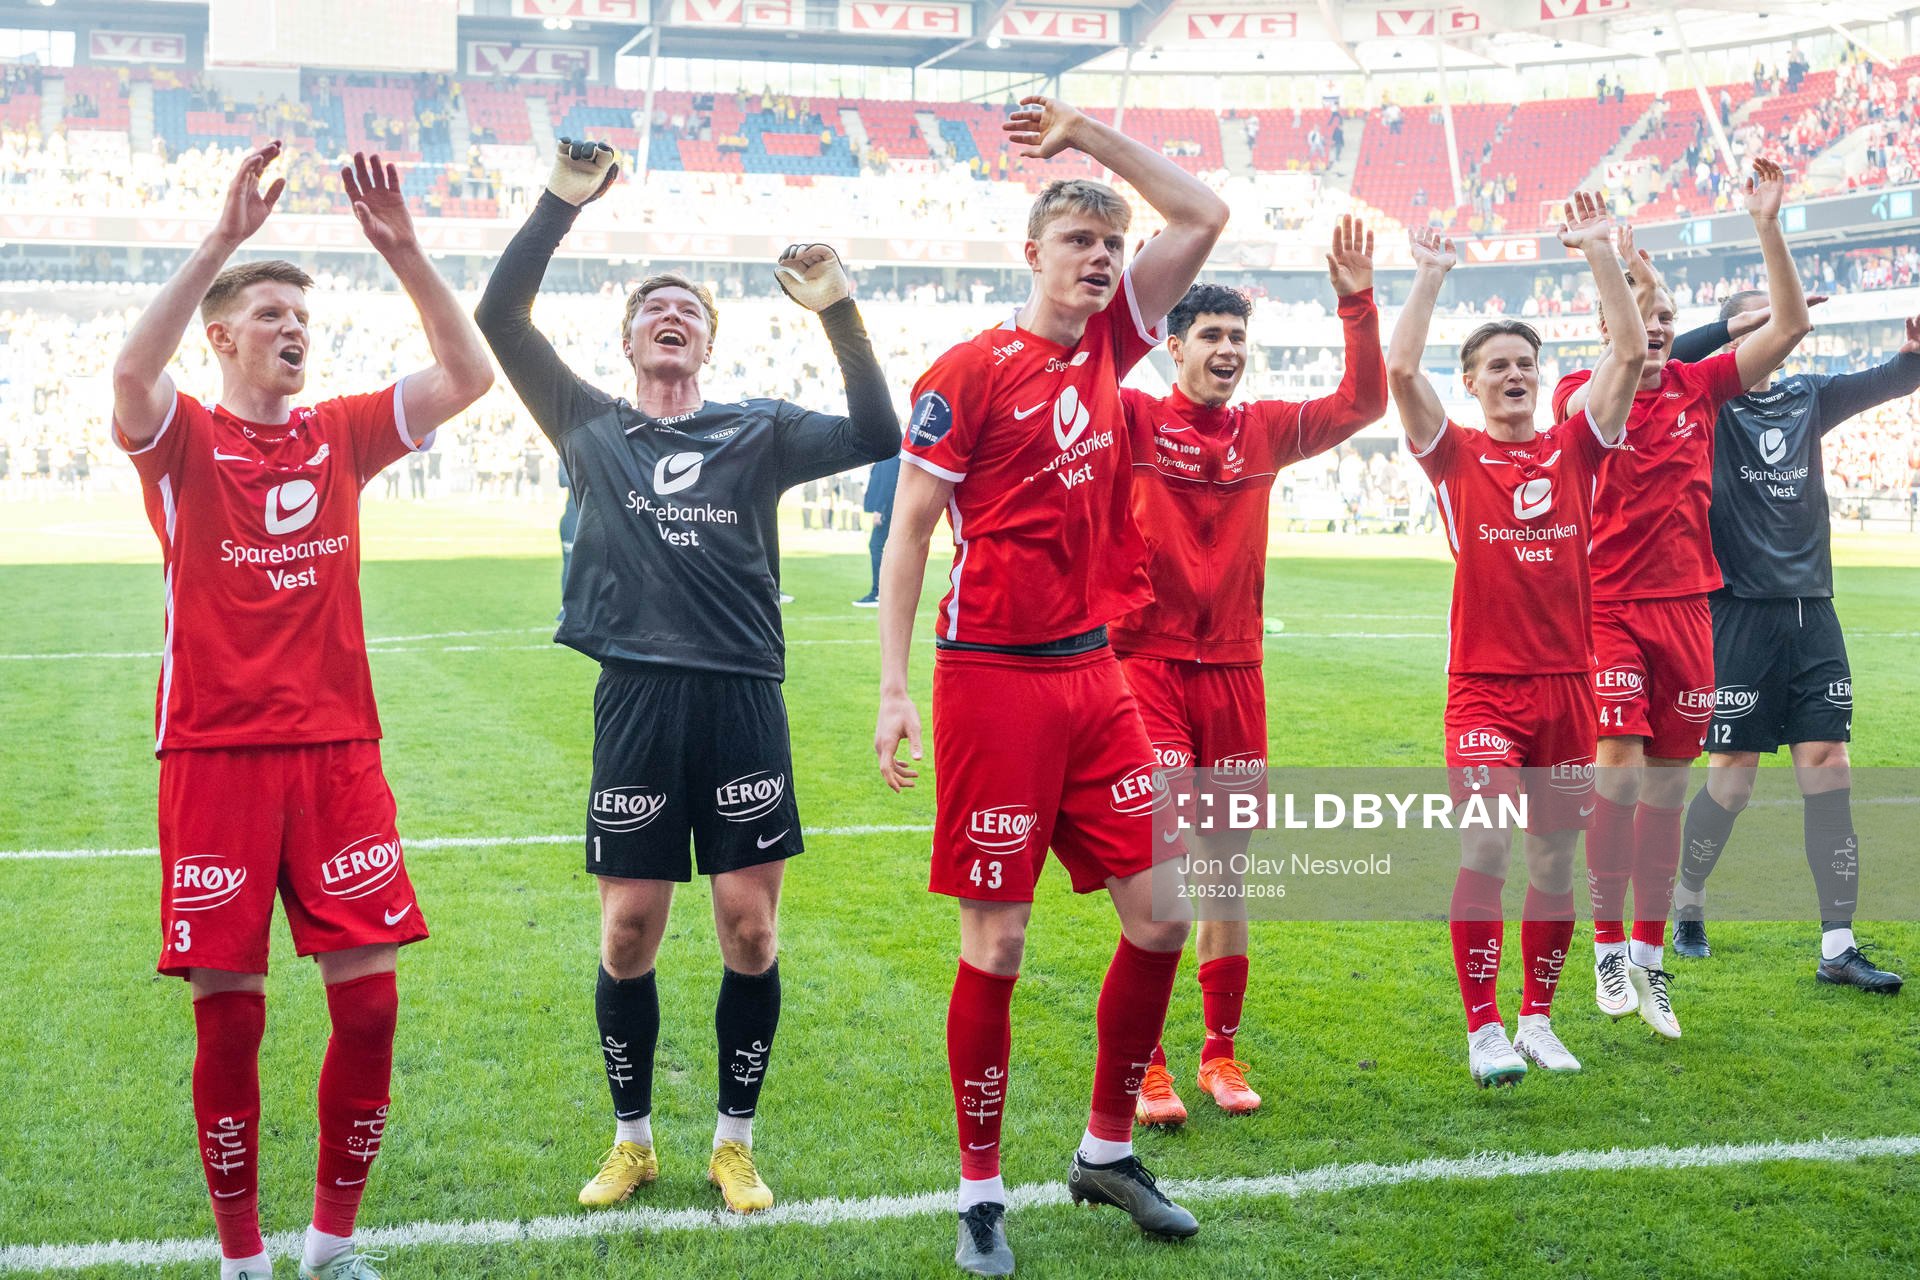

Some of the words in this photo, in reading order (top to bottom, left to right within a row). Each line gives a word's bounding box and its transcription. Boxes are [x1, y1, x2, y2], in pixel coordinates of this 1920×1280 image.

[853, 5, 955, 33] VG
[1003, 10, 1101, 38] VG
[1190, 13, 1293, 38] VG
[96, 35, 177, 57] VG
[479, 47, 585, 74] VG
[652, 234, 729, 255] VG
[890, 239, 964, 260] VG
[1469, 239, 1538, 260] VG
[1180, 445, 1201, 455] 1000
[1058, 463, 1095, 490] Vest
[1162, 457, 1201, 472] Fjordkraft
[1767, 485, 1797, 497] Vest
[657, 522, 699, 547] Vest
[1479, 523, 1578, 544] Sparebanken
[220, 535, 349, 567] Sparebanken
[1514, 546, 1553, 562] Vest
[266, 566, 317, 591] Vest
[1716, 690, 1757, 706] ERØY
[1600, 705, 1624, 727] 41
[1714, 724, 1732, 744] 12
[593, 791, 661, 815] LERØY
[716, 775, 783, 806] LERØY
[593, 836, 601, 862] 1
[1832, 837, 1857, 881] tide
[173, 864, 242, 892] ERØY
[969, 859, 1003, 889] 43
[1466, 938, 1500, 983] tide
[1534, 949, 1567, 989] tide
[731, 1040, 769, 1086] tide
